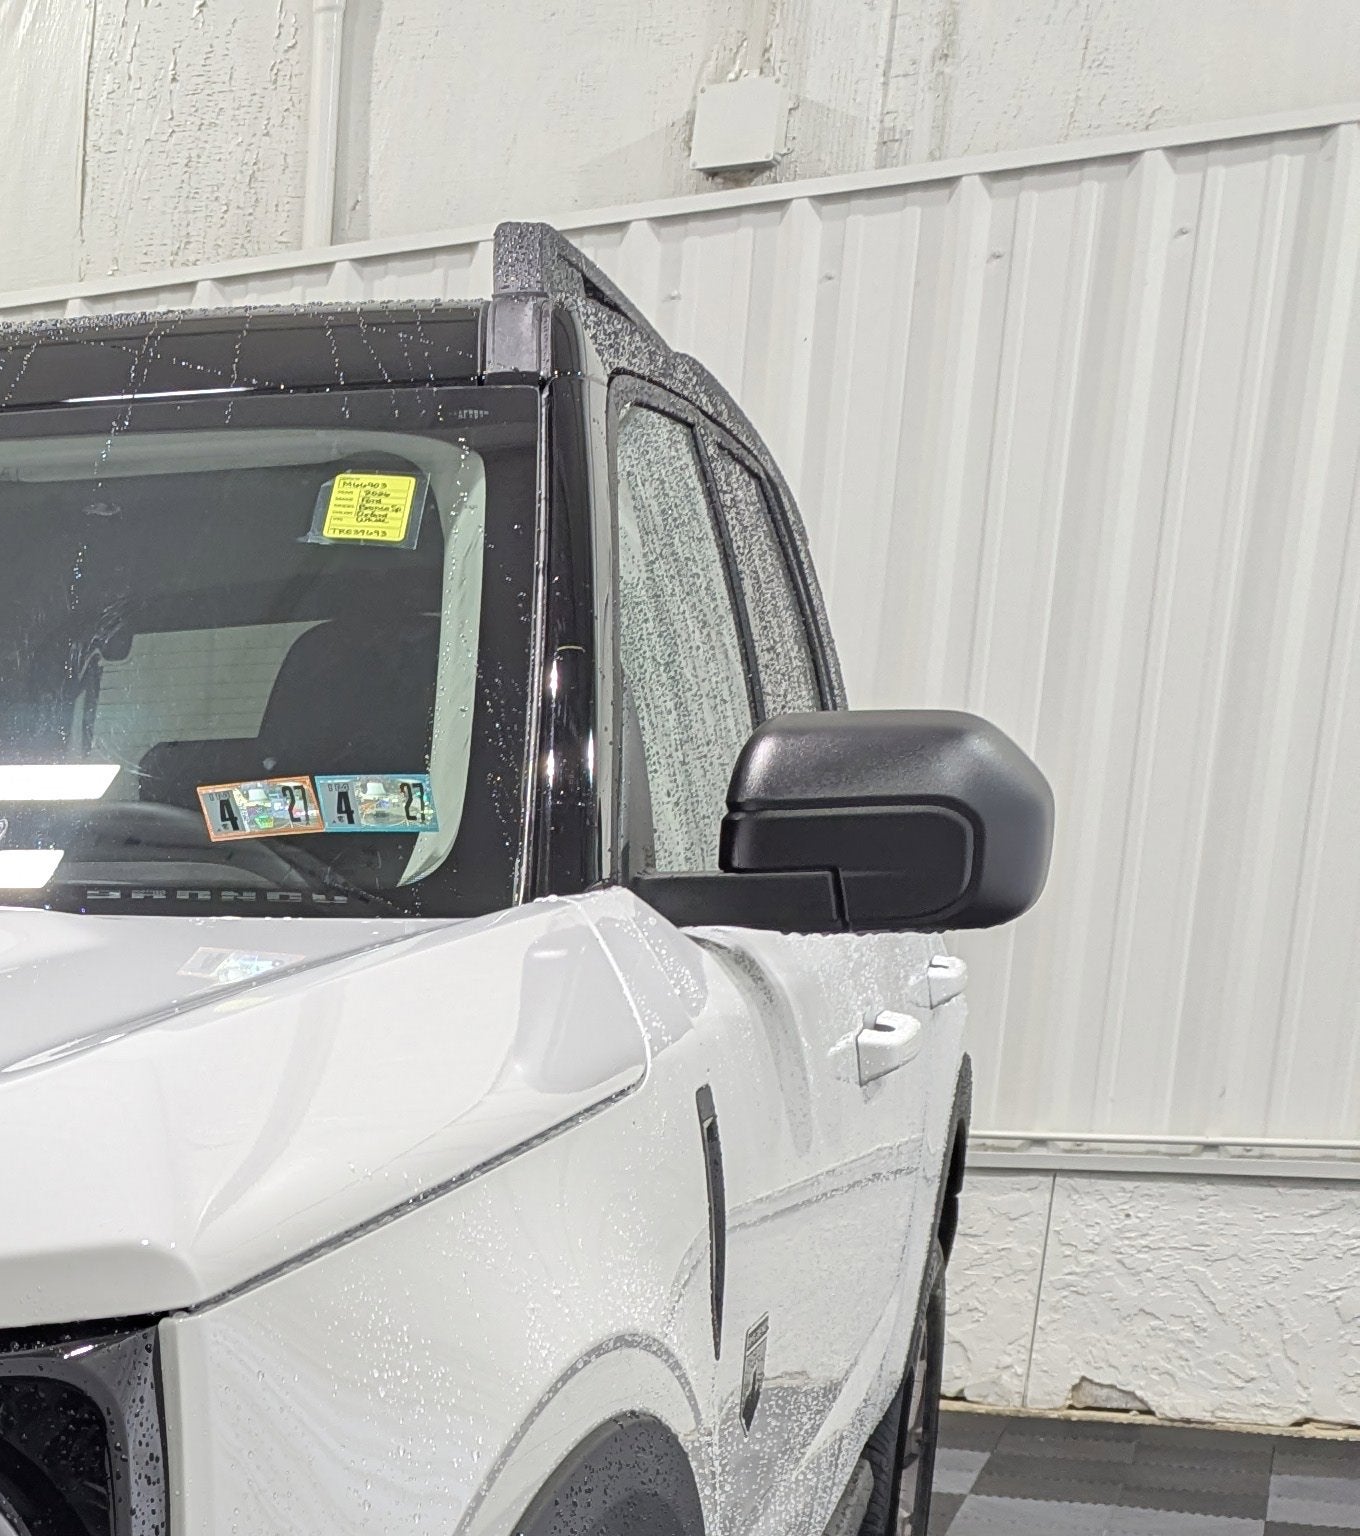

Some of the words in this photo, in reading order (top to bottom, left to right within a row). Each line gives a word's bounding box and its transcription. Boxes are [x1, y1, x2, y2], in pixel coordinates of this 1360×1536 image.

[219, 799, 240, 831] 4
[281, 785, 311, 826] 27
[336, 792, 355, 825] 4
[399, 782, 426, 823] 27
